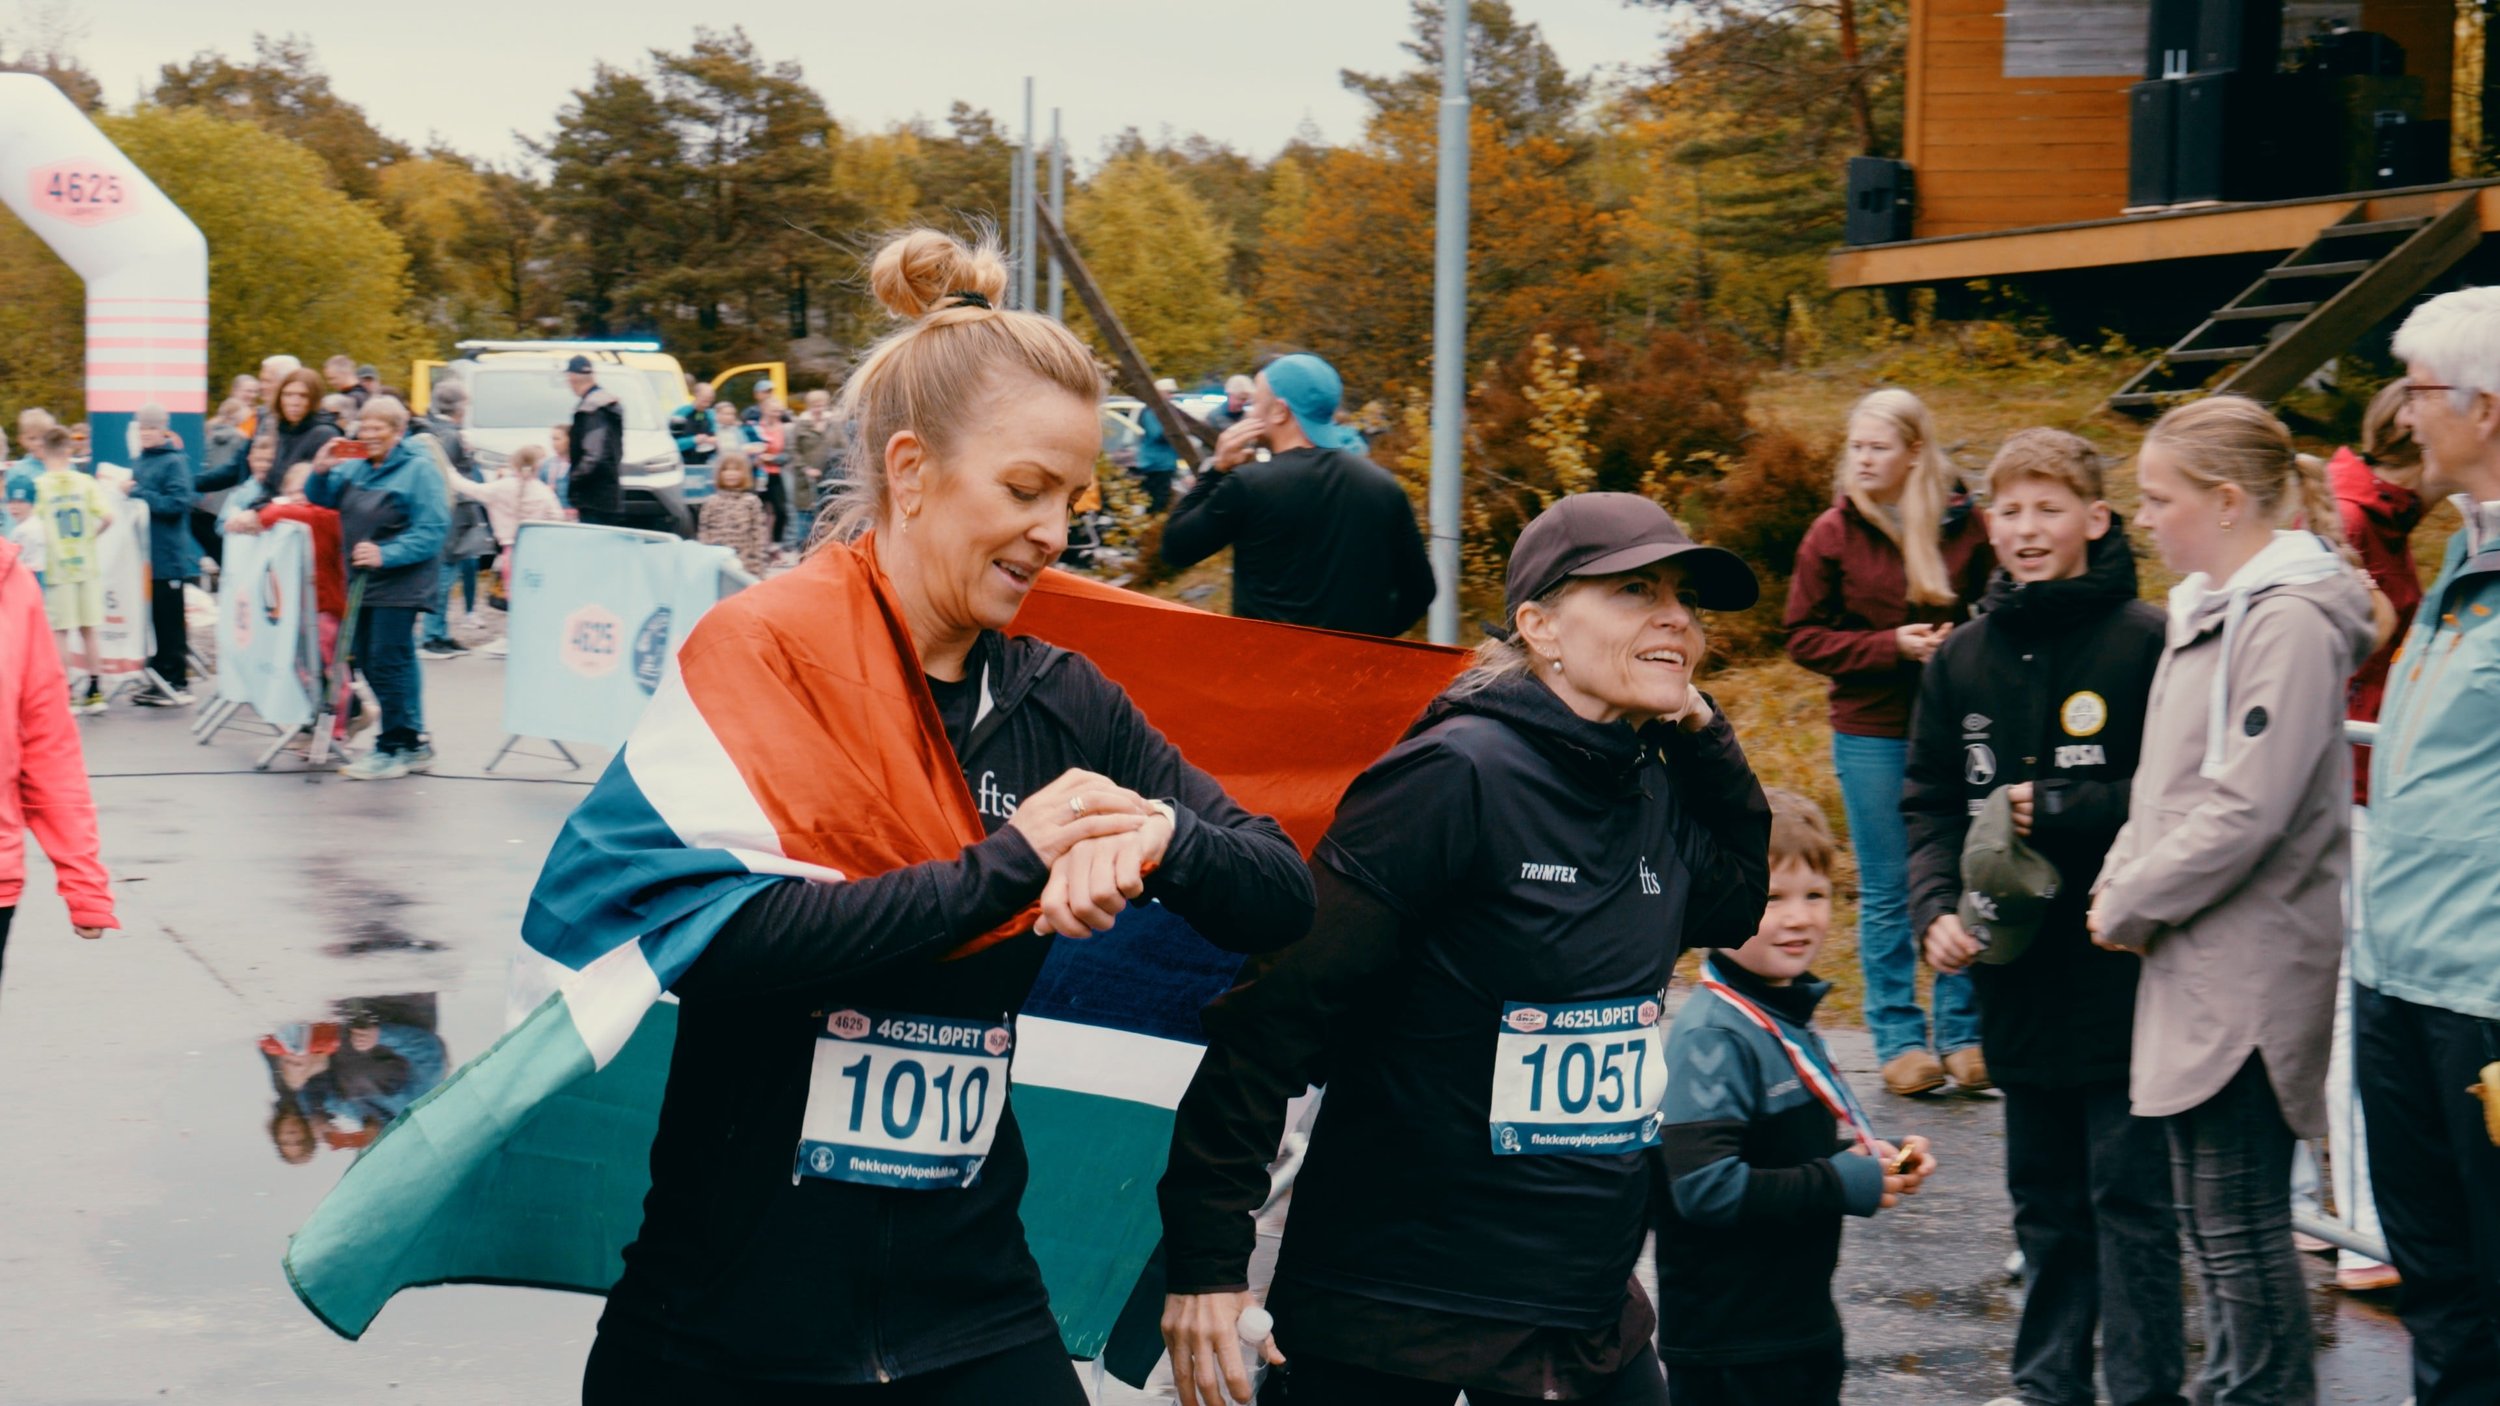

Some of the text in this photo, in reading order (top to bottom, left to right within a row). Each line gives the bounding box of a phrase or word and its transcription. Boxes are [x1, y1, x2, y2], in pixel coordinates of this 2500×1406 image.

[46, 172, 124, 204] 4625
[55, 508, 83, 538] 10
[571, 620, 614, 654] 4625
[978, 770, 1018, 819] fts
[1520, 862, 1578, 884] TRIMTEX
[1639, 856, 1661, 894] fts
[834, 1015, 864, 1031] 4625
[877, 1018, 981, 1048] 4625LØPET
[1552, 1006, 1635, 1029] 4625LØPET
[1522, 1038, 1647, 1114] 1057
[842, 1054, 990, 1144] 1010
